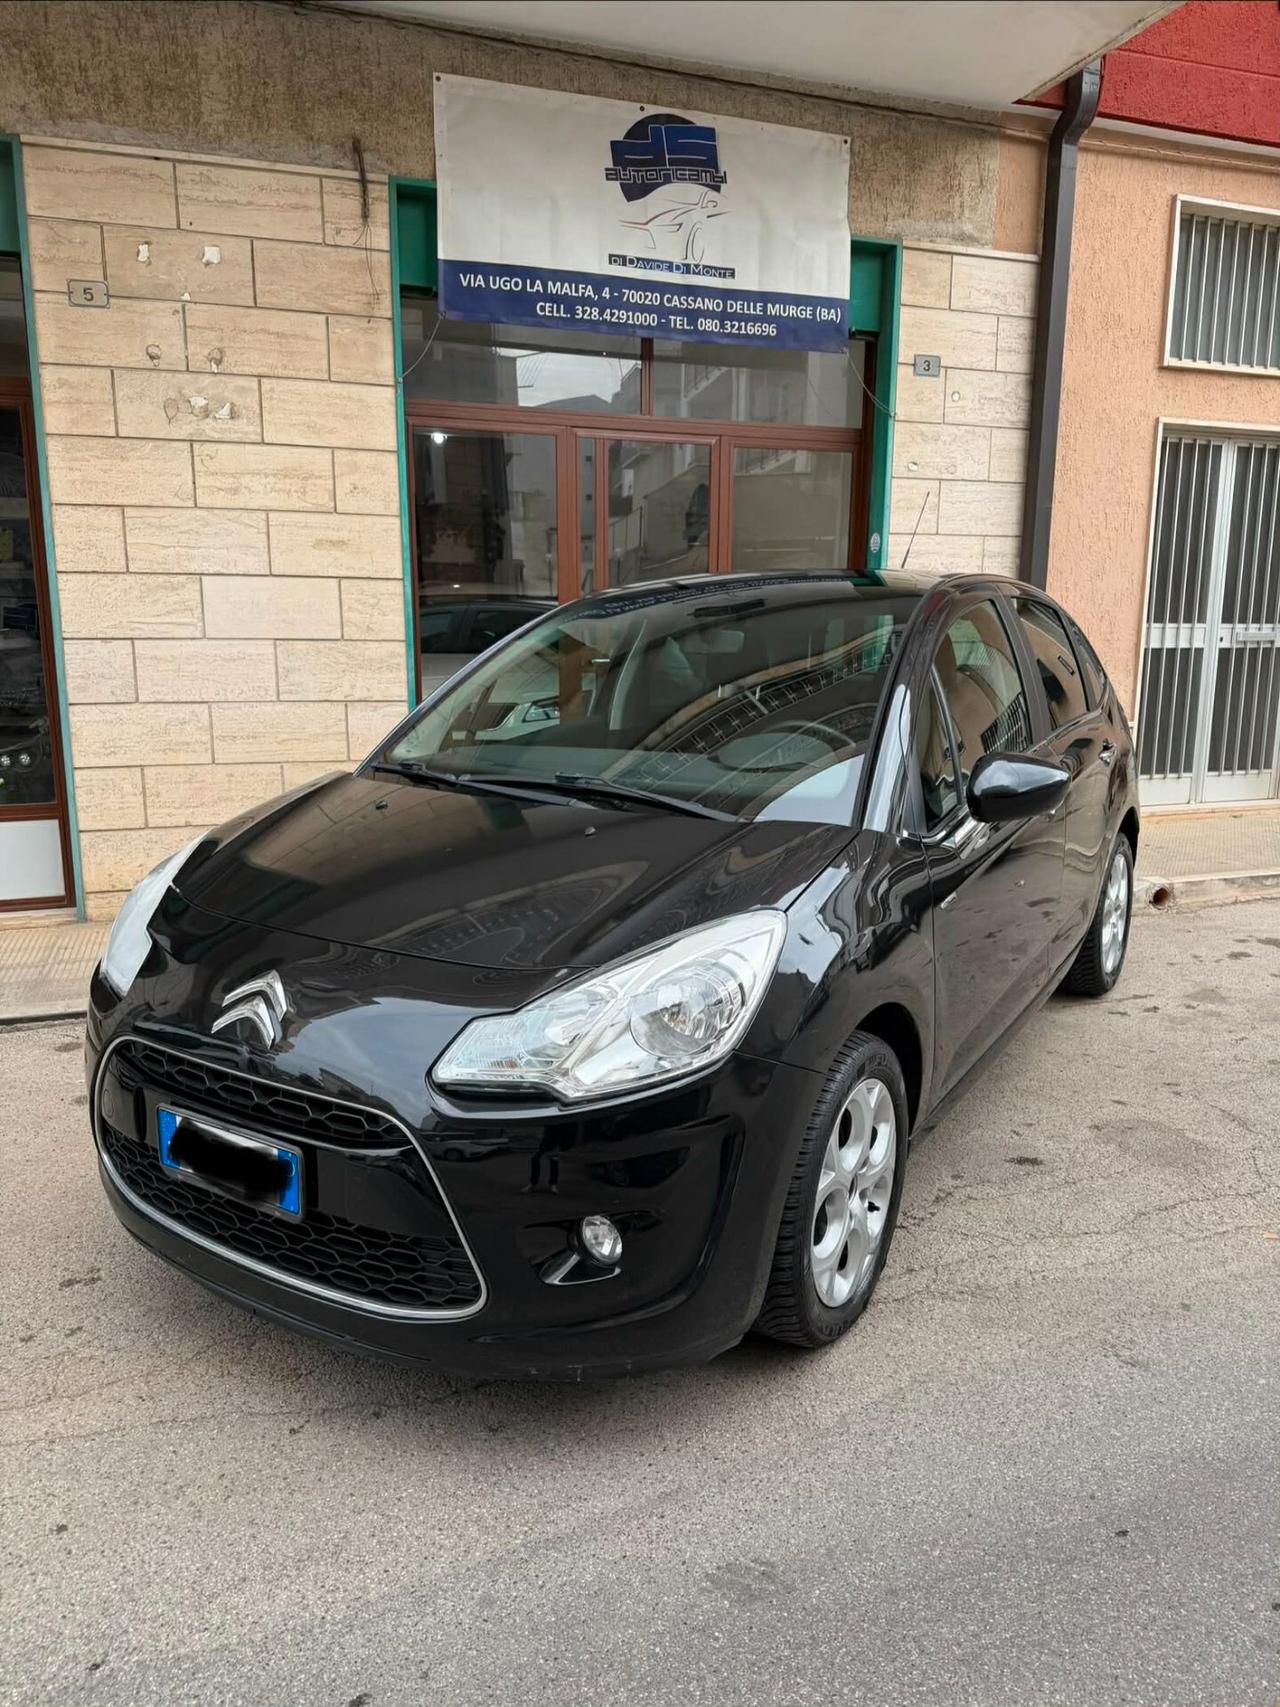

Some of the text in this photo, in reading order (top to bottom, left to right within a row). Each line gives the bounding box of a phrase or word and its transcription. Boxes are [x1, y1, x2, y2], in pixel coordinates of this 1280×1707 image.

[83, 287, 94, 302] 5
[459, 273, 486, 288] VIA
[490, 275, 522, 292] UGO
[526, 278, 544, 294] LA
[547, 281, 599, 301] MALFA,
[602, 287, 610, 300] 4
[622, 289, 660, 306] 70020
[663, 293, 723, 312] CASSANO
[726, 300, 764, 315] DELLE
[767, 303, 813, 319] MURGE
[816, 306, 841, 324] (BA)
[536, 302, 571, 318] CELL.
[575, 305, 658, 327] 328.4291000
[669, 315, 694, 330] TEL.
[697, 318, 777, 337] 080.3216696
[923, 359, 931, 372] 3
